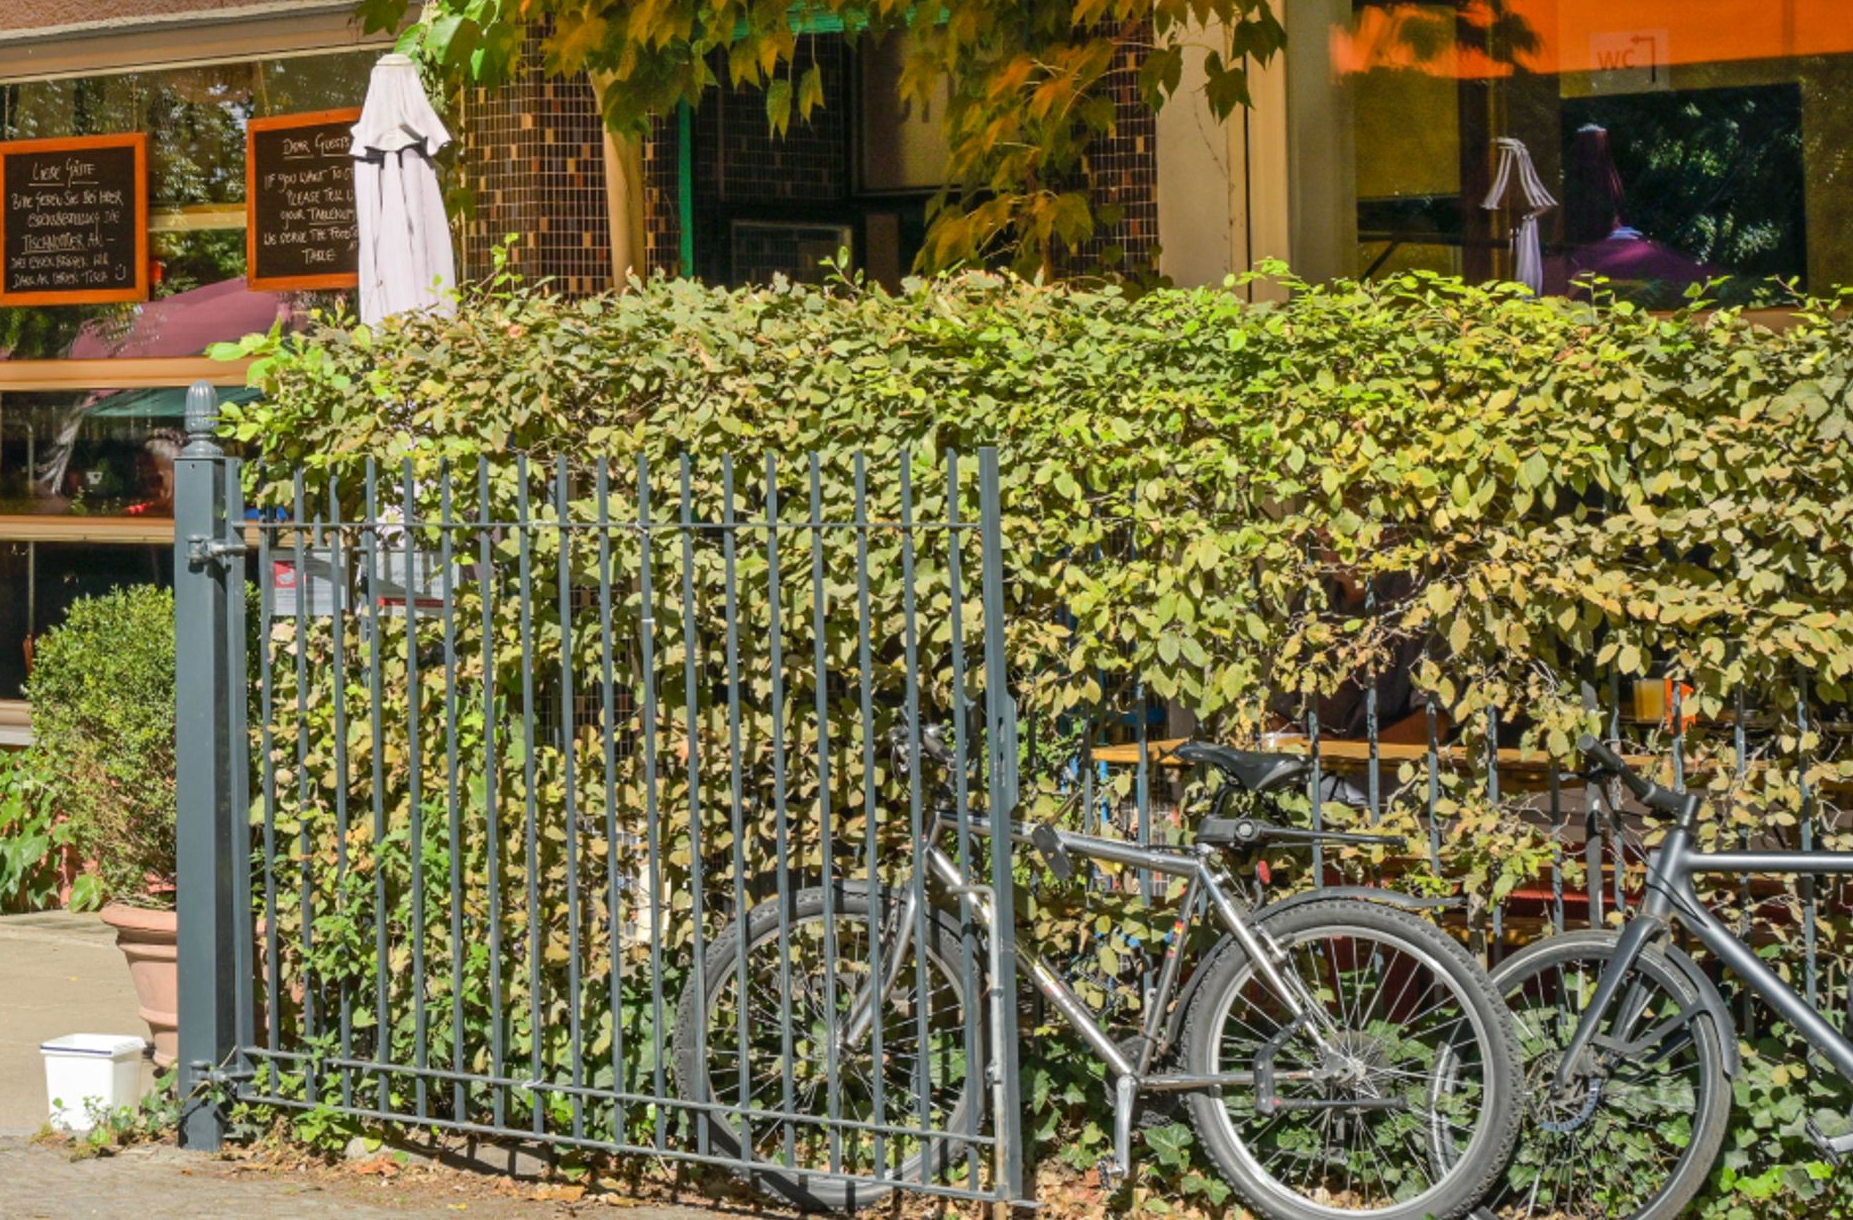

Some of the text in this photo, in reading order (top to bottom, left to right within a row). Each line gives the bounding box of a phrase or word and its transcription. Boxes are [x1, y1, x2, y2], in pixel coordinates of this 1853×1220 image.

[1596, 48, 1636, 71] WC
[286, 189, 320, 206] PLEASE
[301, 248, 337, 265] TABLE
